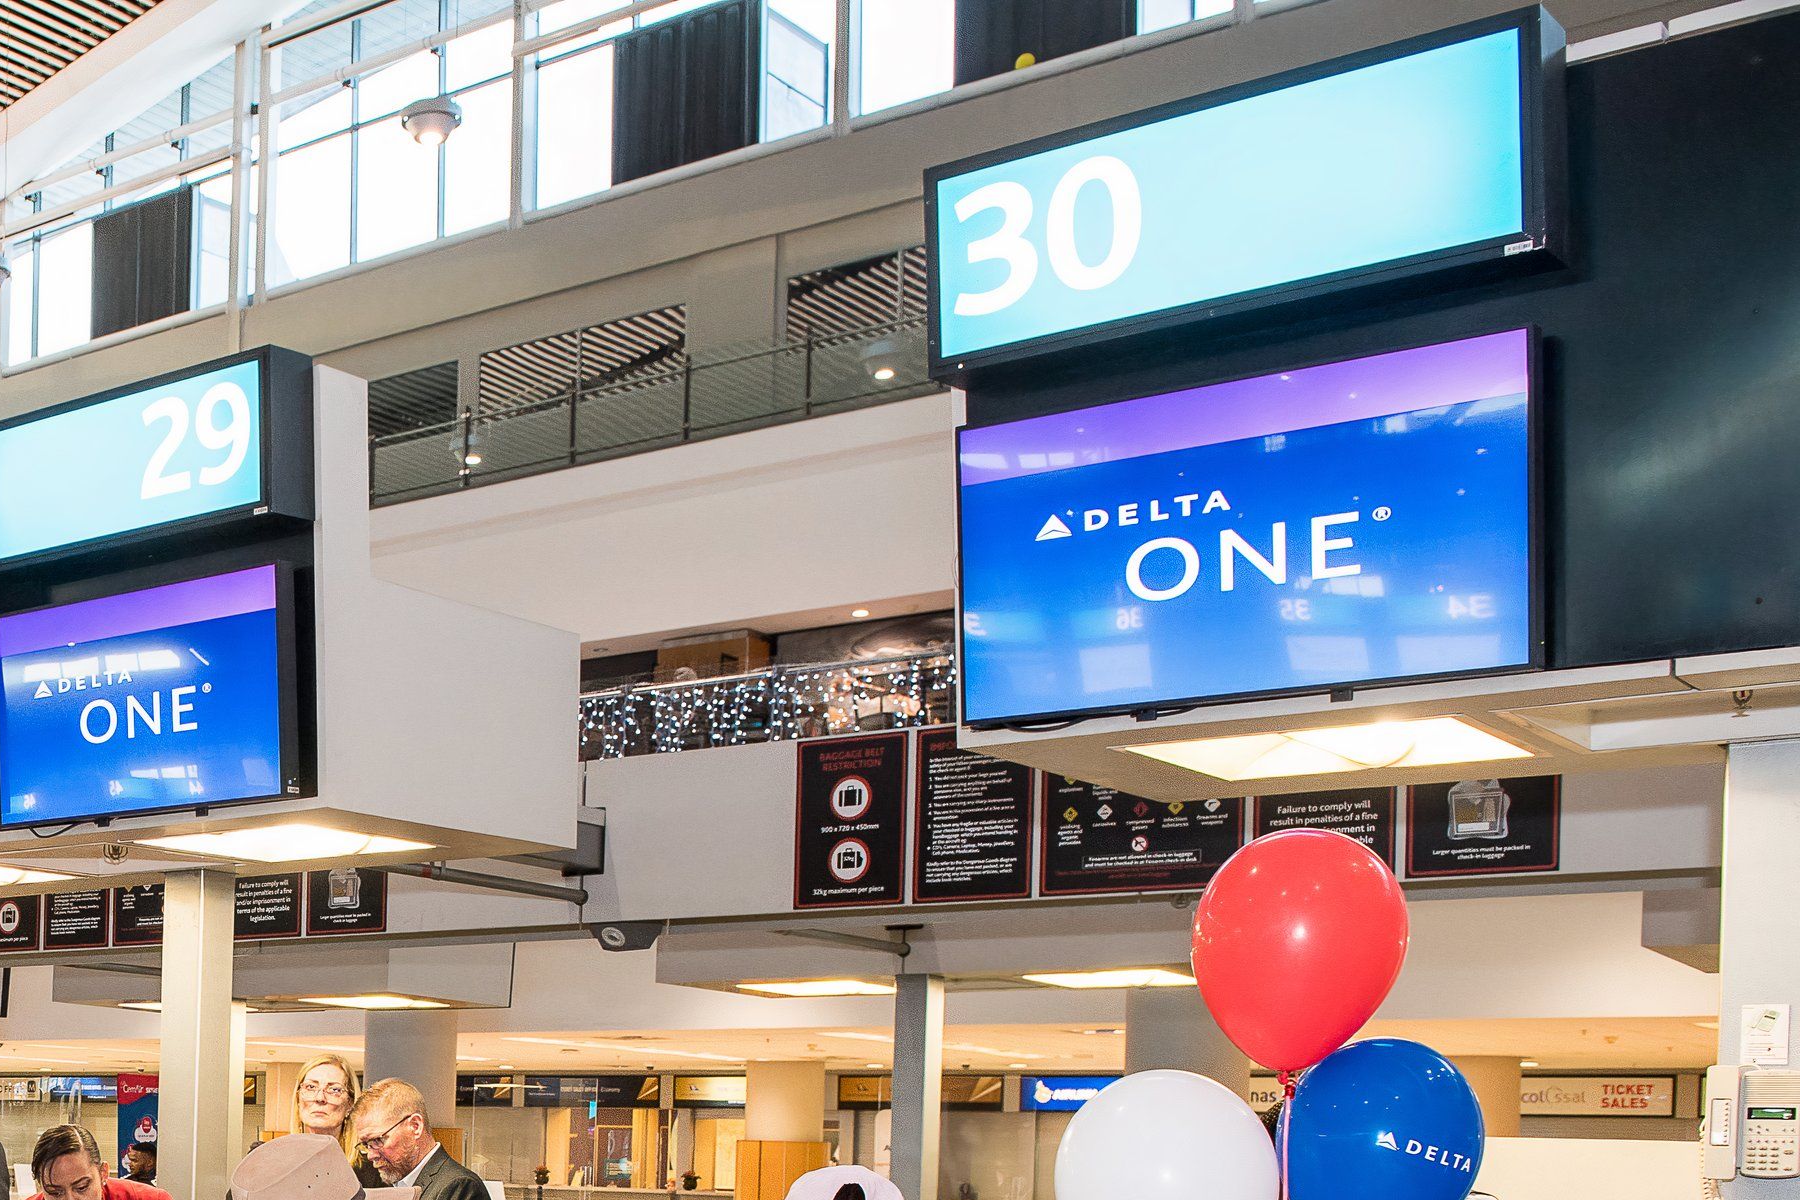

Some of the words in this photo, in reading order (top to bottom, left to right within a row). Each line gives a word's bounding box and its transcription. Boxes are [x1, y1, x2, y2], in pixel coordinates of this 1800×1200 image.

[954, 155, 1142, 317] 30
[141, 382, 250, 500] 29
[1084, 490, 1231, 532] DELTA
[57, 668, 134, 695] DELTA
[1277, 806, 1306, 814] Failure
[1320, 801, 1352, 812] comply
[1354, 800, 1370, 808] will
[1270, 817, 1293, 826] result
[1305, 814, 1343, 825] penalties
[1344, 813, 1354, 821] of
[1361, 812, 1378, 820] fine
[1367, 824, 1375, 832] in
[261, 880, 279, 888] comply
[1602, 1084, 1654, 1096] TICKET
[1601, 1097, 1649, 1109] SALES
[1405, 1138, 1472, 1173] DELTA
